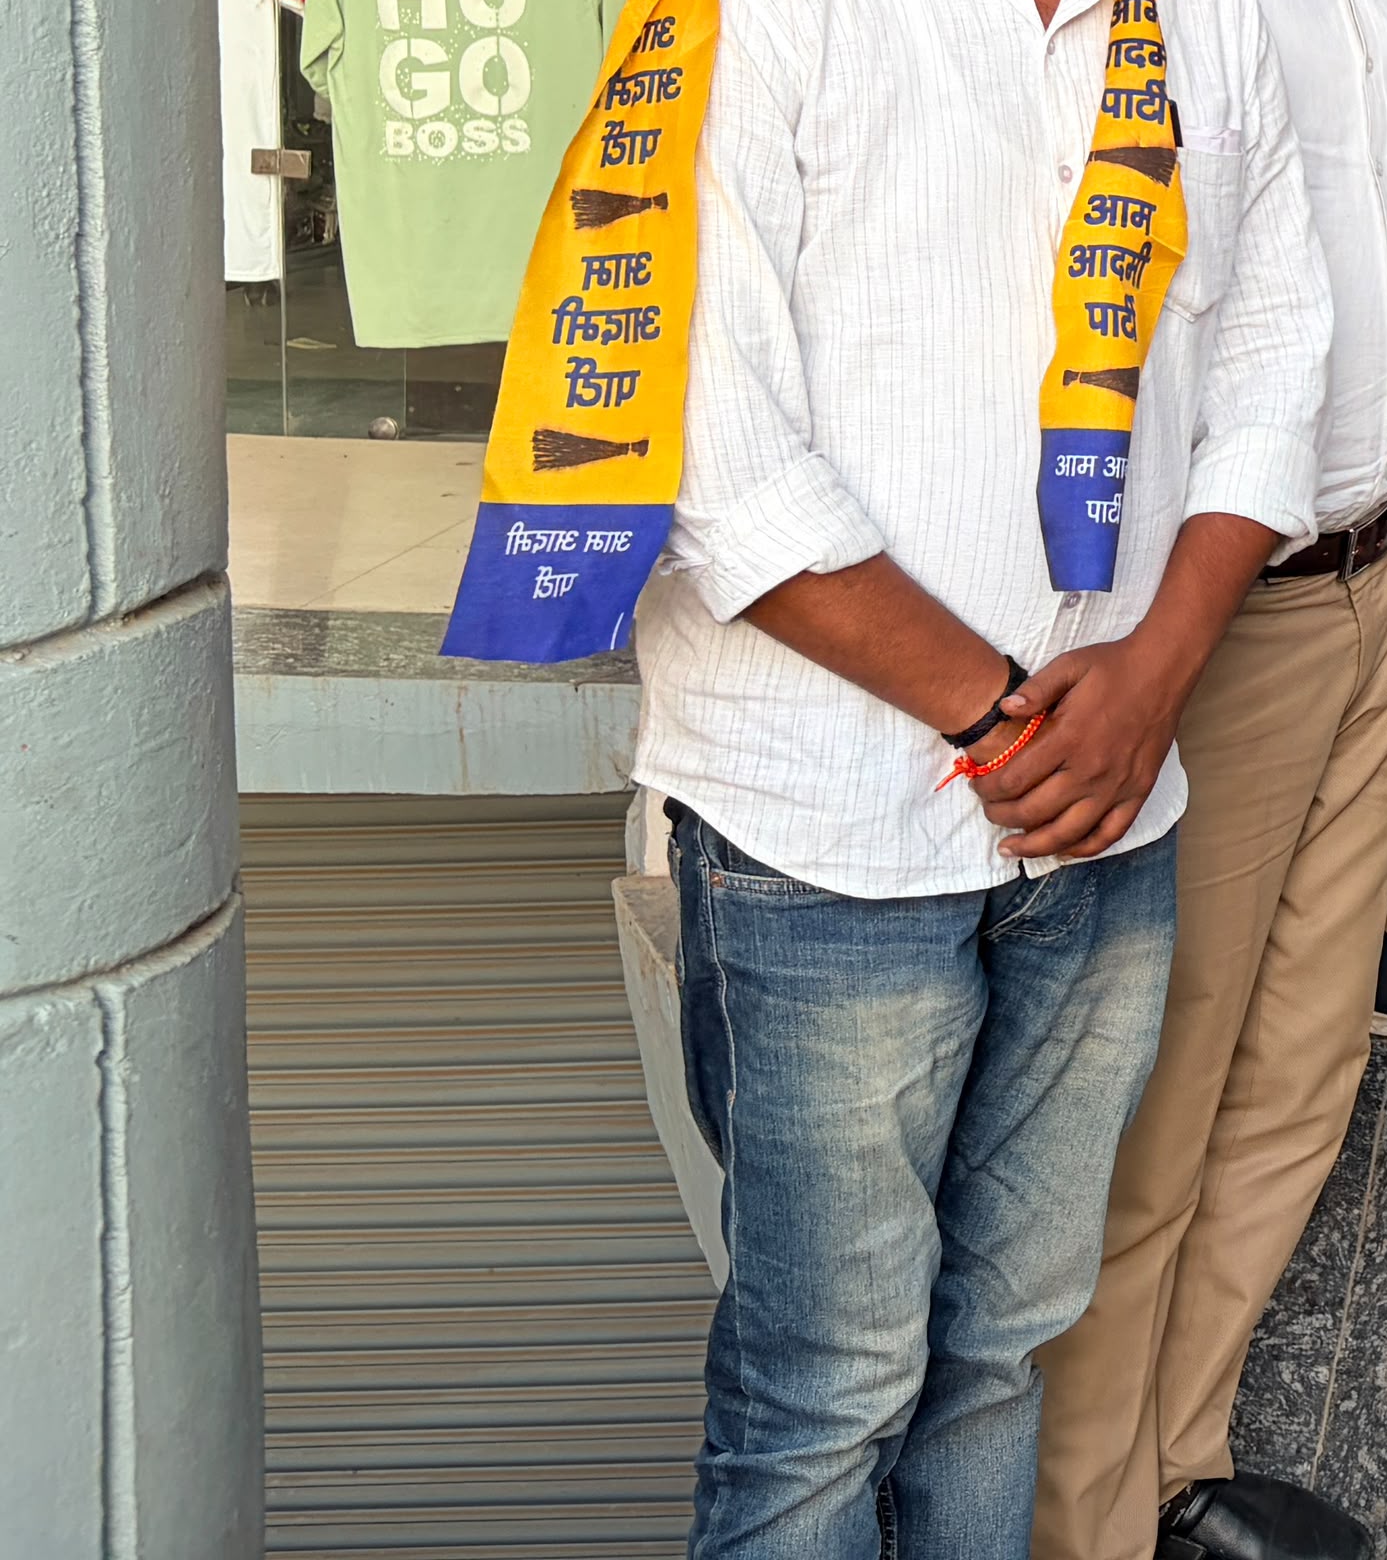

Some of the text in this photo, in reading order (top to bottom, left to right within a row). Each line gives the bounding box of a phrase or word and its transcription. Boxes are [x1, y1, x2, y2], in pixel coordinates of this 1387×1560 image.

[379, 35, 532, 120] GO
[385, 119, 532, 158] BOSS
[1084, 194, 1157, 236] आम
[1068, 241, 1152, 290] आदमी
[1055, 454, 1098, 478] आम
